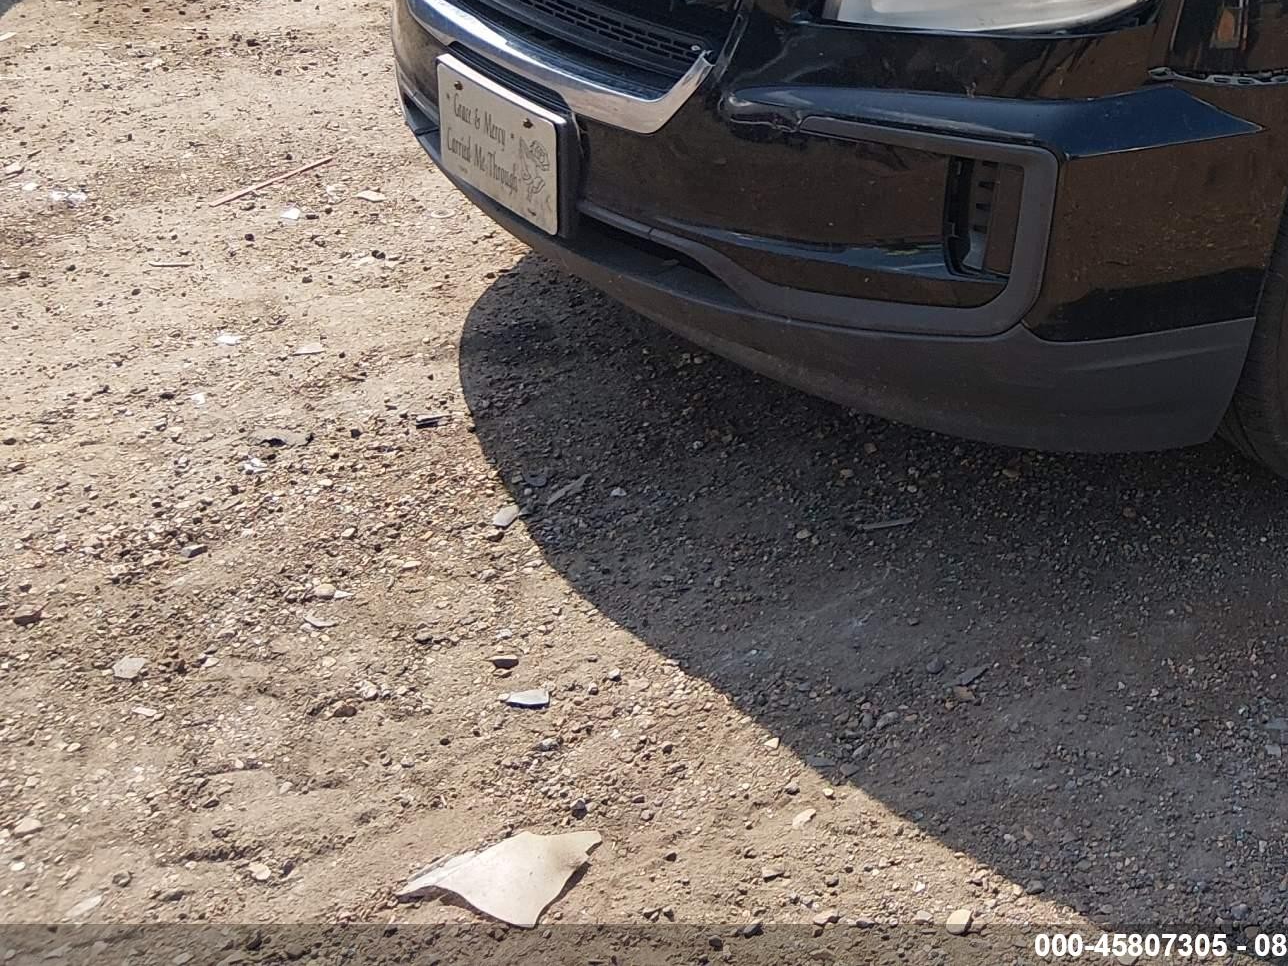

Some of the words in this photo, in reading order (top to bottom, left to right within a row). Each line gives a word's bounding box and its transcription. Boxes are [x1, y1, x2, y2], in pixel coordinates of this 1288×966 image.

[447, 127, 471, 165] Carried
[474, 144, 486, 172] Me
[485, 111, 507, 152] Mercy
